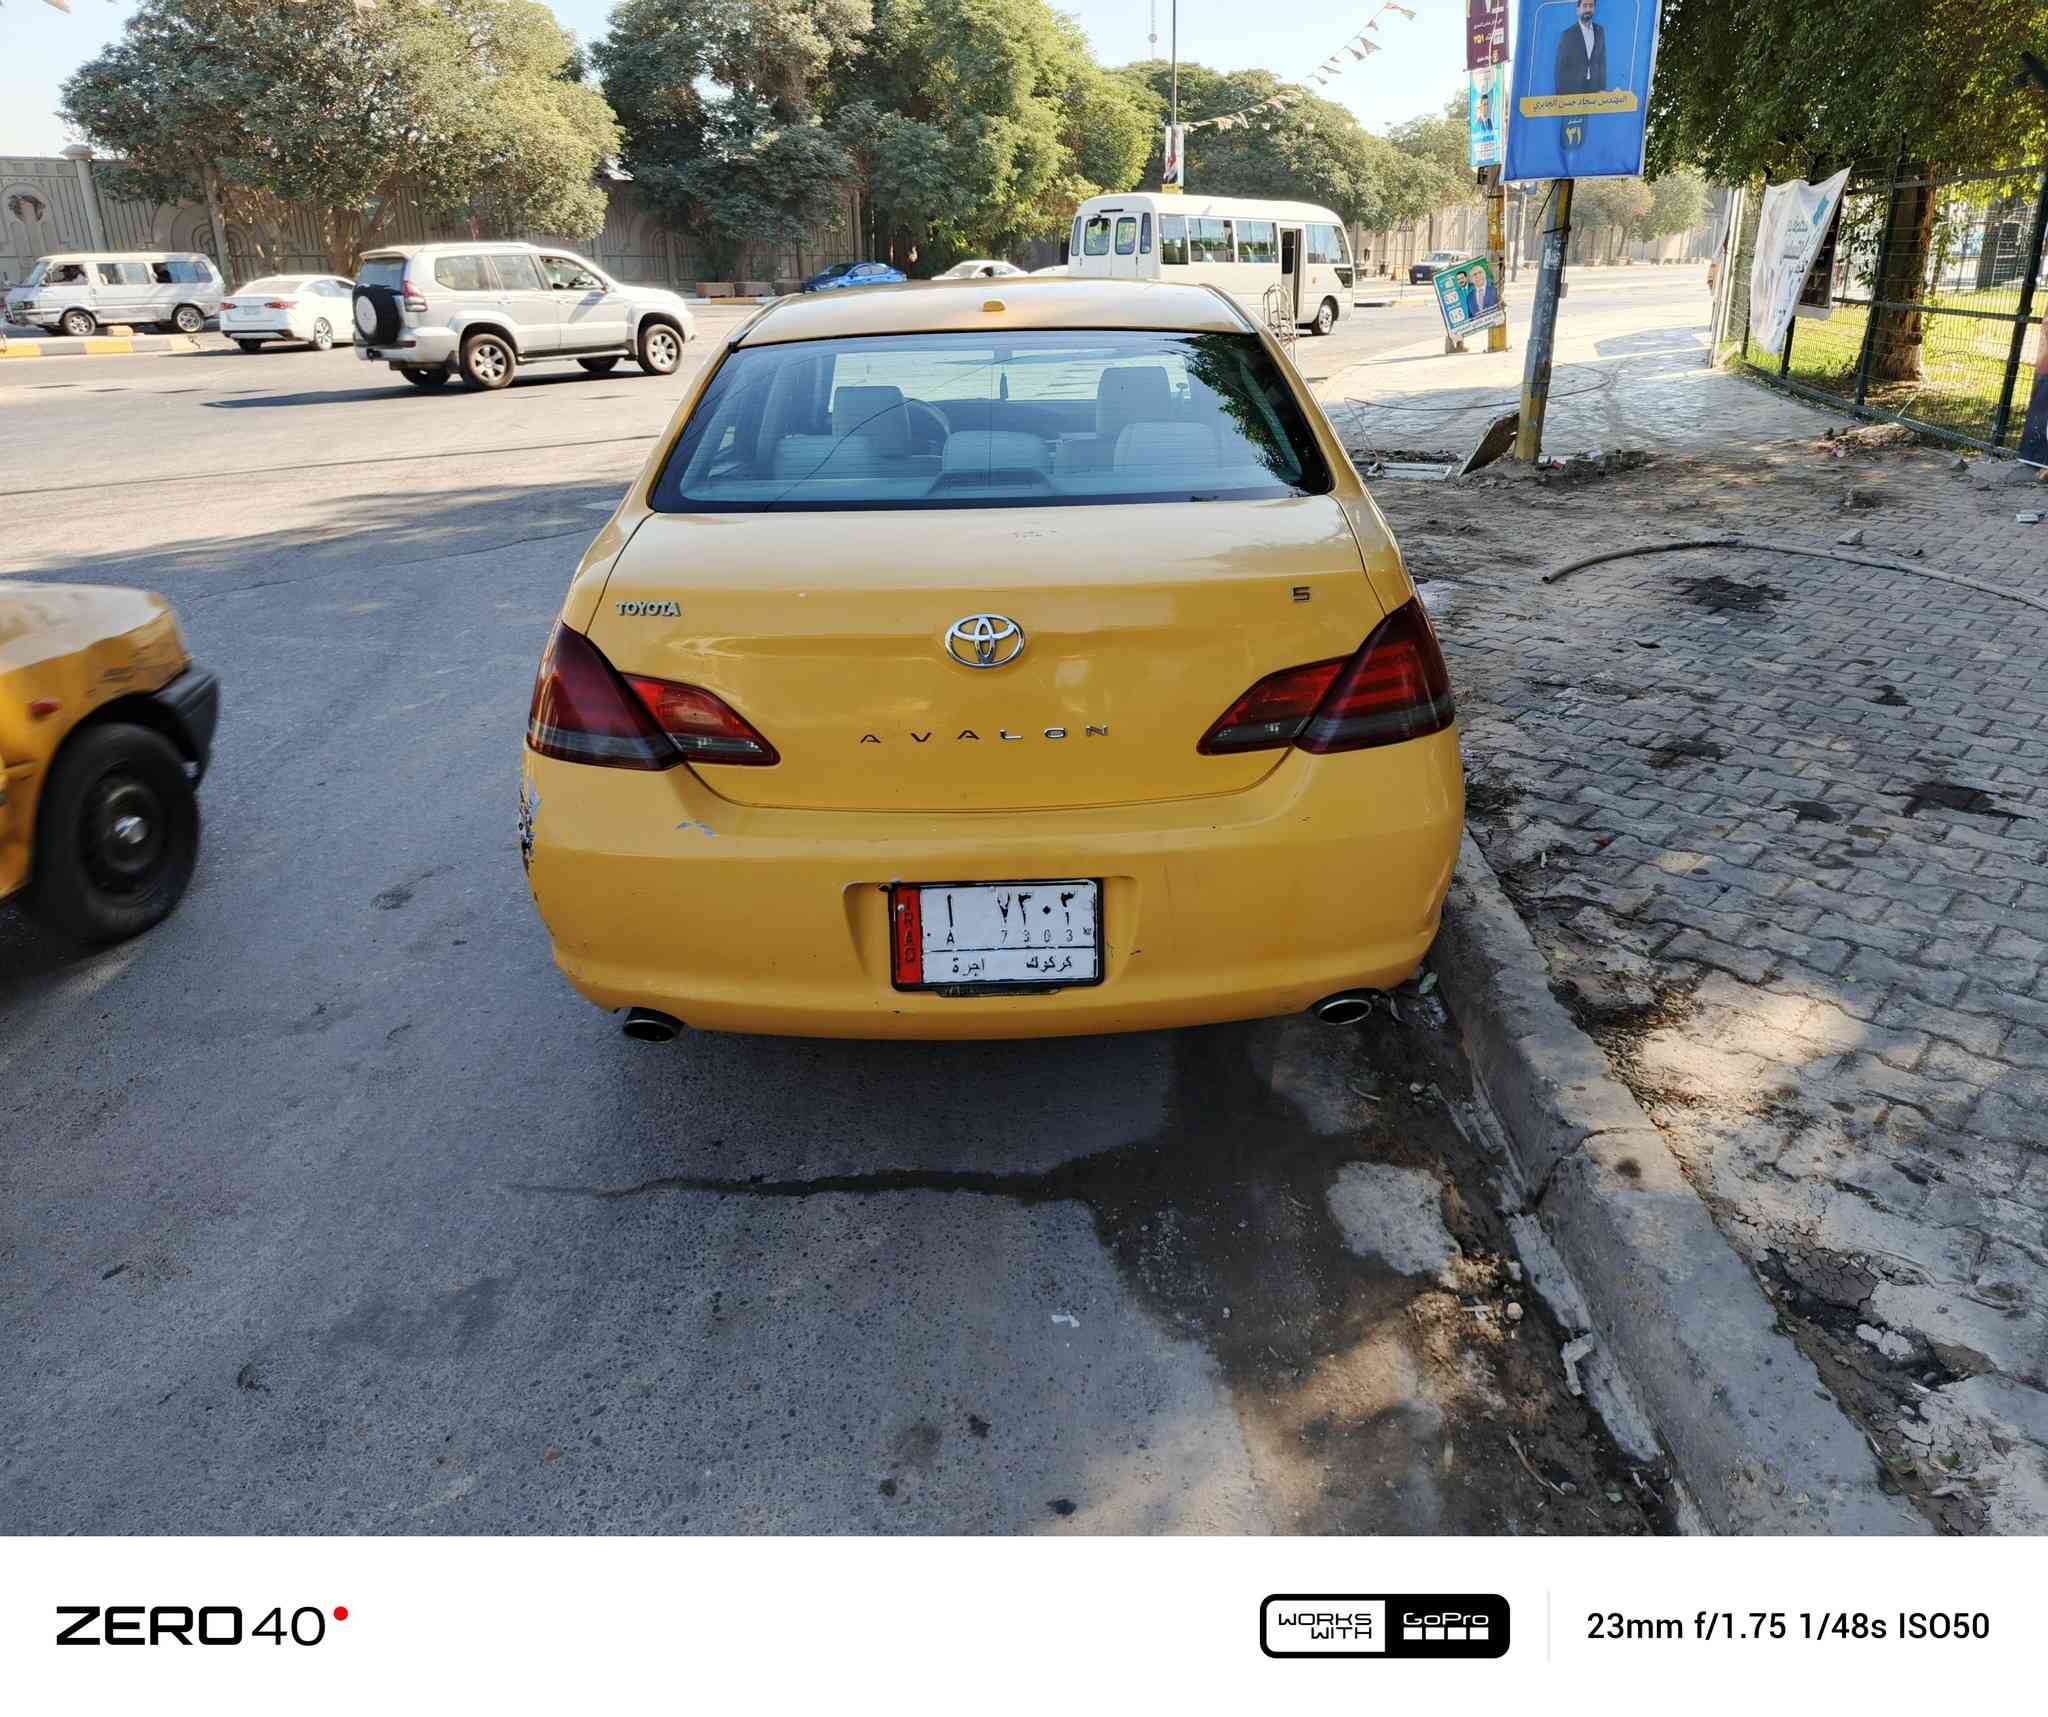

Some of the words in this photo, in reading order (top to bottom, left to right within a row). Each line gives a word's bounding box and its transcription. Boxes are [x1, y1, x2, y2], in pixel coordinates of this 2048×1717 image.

[616, 601, 681, 617] TOYOTA
[860, 725, 1109, 744] AVALON
[1026, 955, 1073, 973] كركوك
